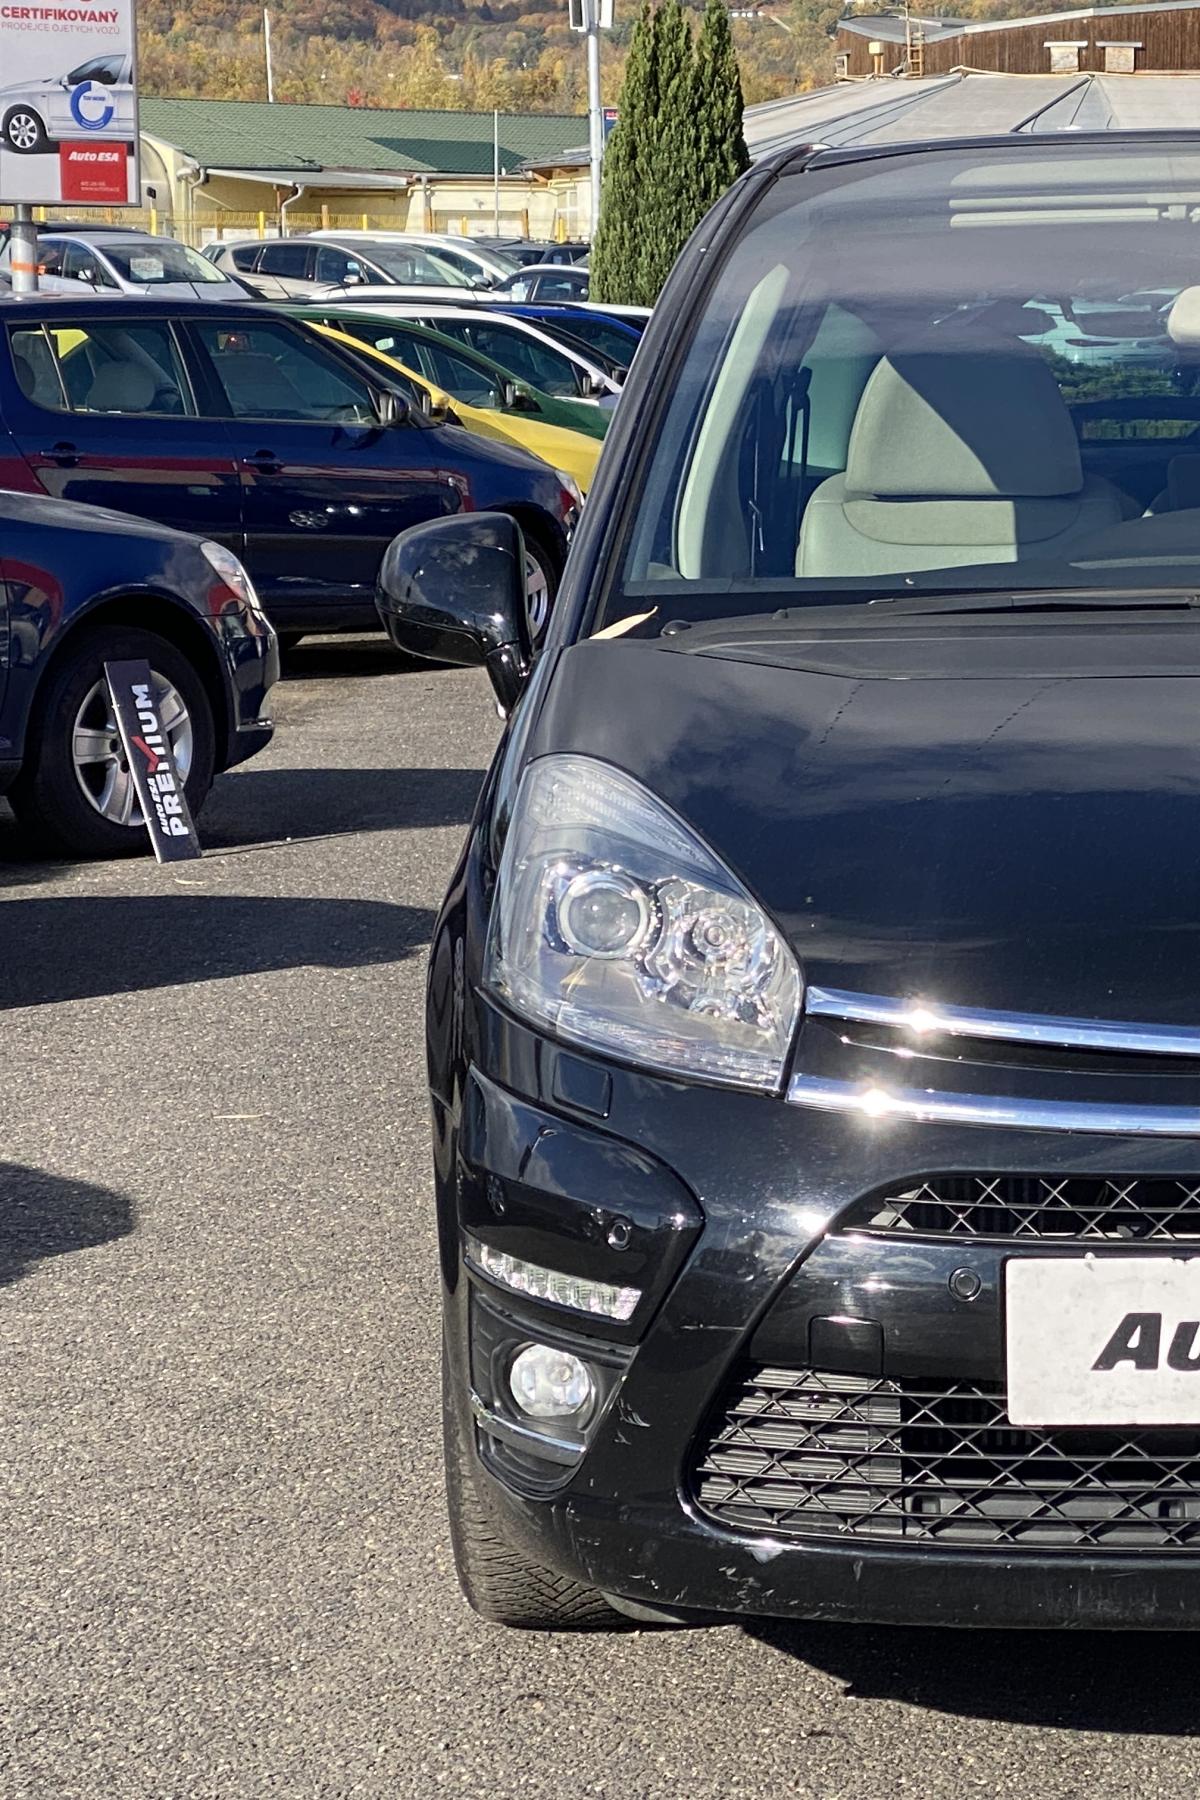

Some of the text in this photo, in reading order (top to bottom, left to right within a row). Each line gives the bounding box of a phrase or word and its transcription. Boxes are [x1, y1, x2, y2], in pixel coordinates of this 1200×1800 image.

[1, 6, 118, 23] CERTIFIKOVANÝ
[1, 21, 50, 32] PRODEJCE
[69, 151, 119, 162] Auto ESA
[147, 777, 172, 836] Auto ESA
